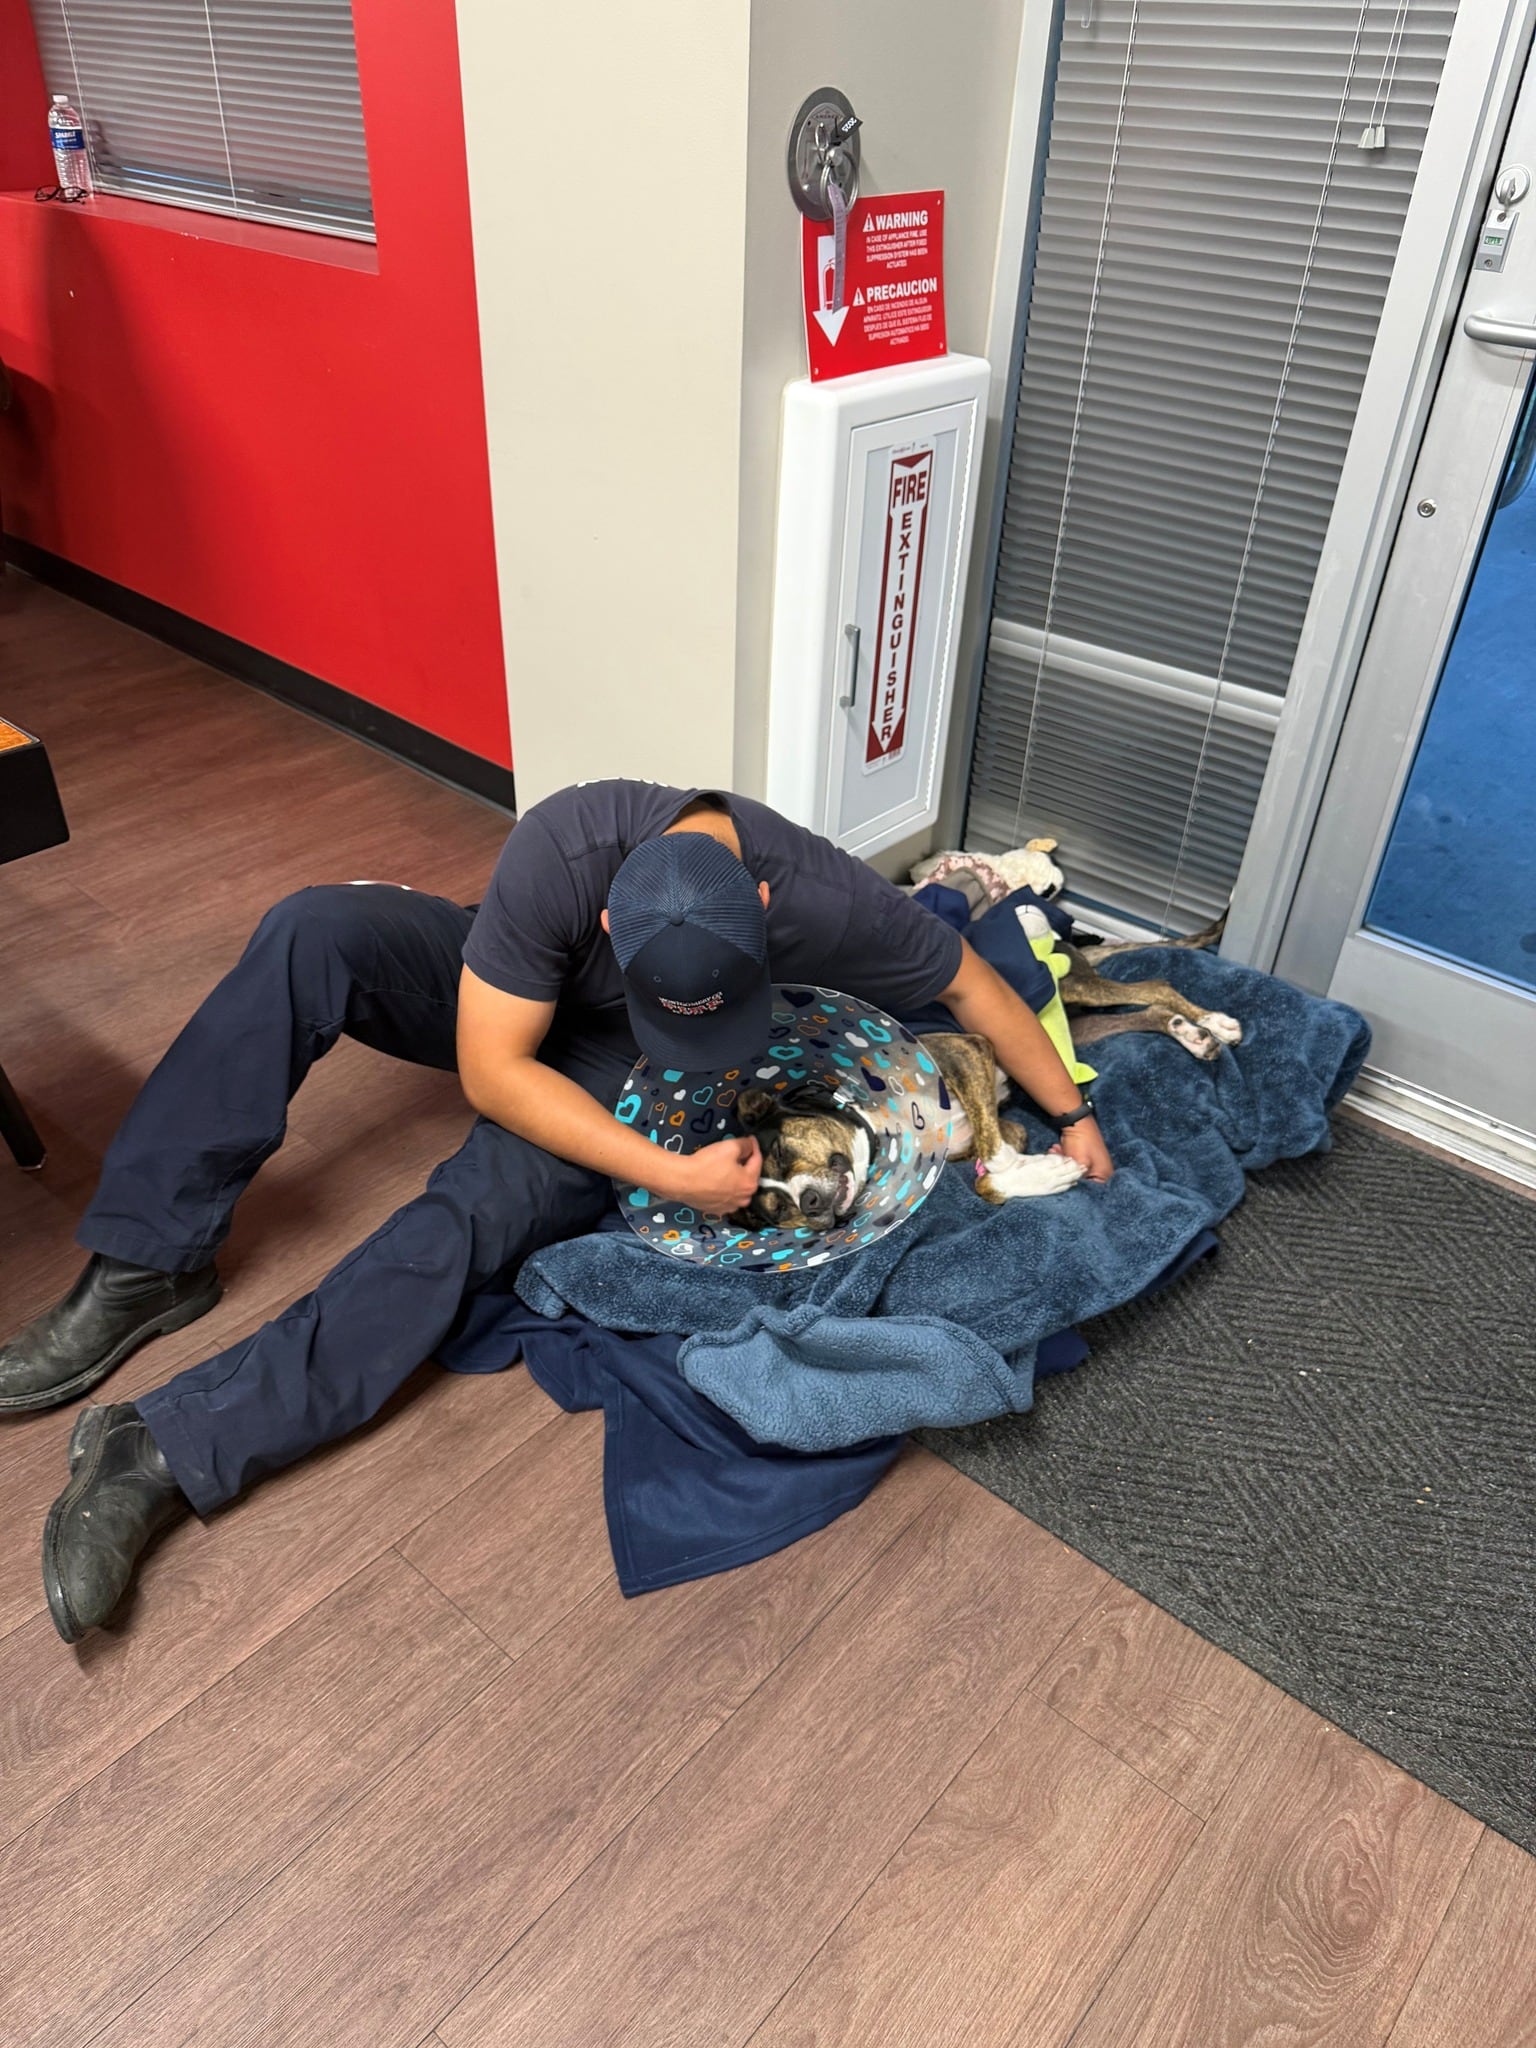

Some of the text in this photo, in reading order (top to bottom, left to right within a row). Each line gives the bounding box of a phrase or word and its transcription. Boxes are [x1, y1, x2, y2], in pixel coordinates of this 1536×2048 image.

[875, 210, 928, 231] WARNING
[866, 277, 937, 303] PRECAUCION
[892, 471, 927, 508] FIRE
[880, 511, 913, 743] EXTINGUISHER
